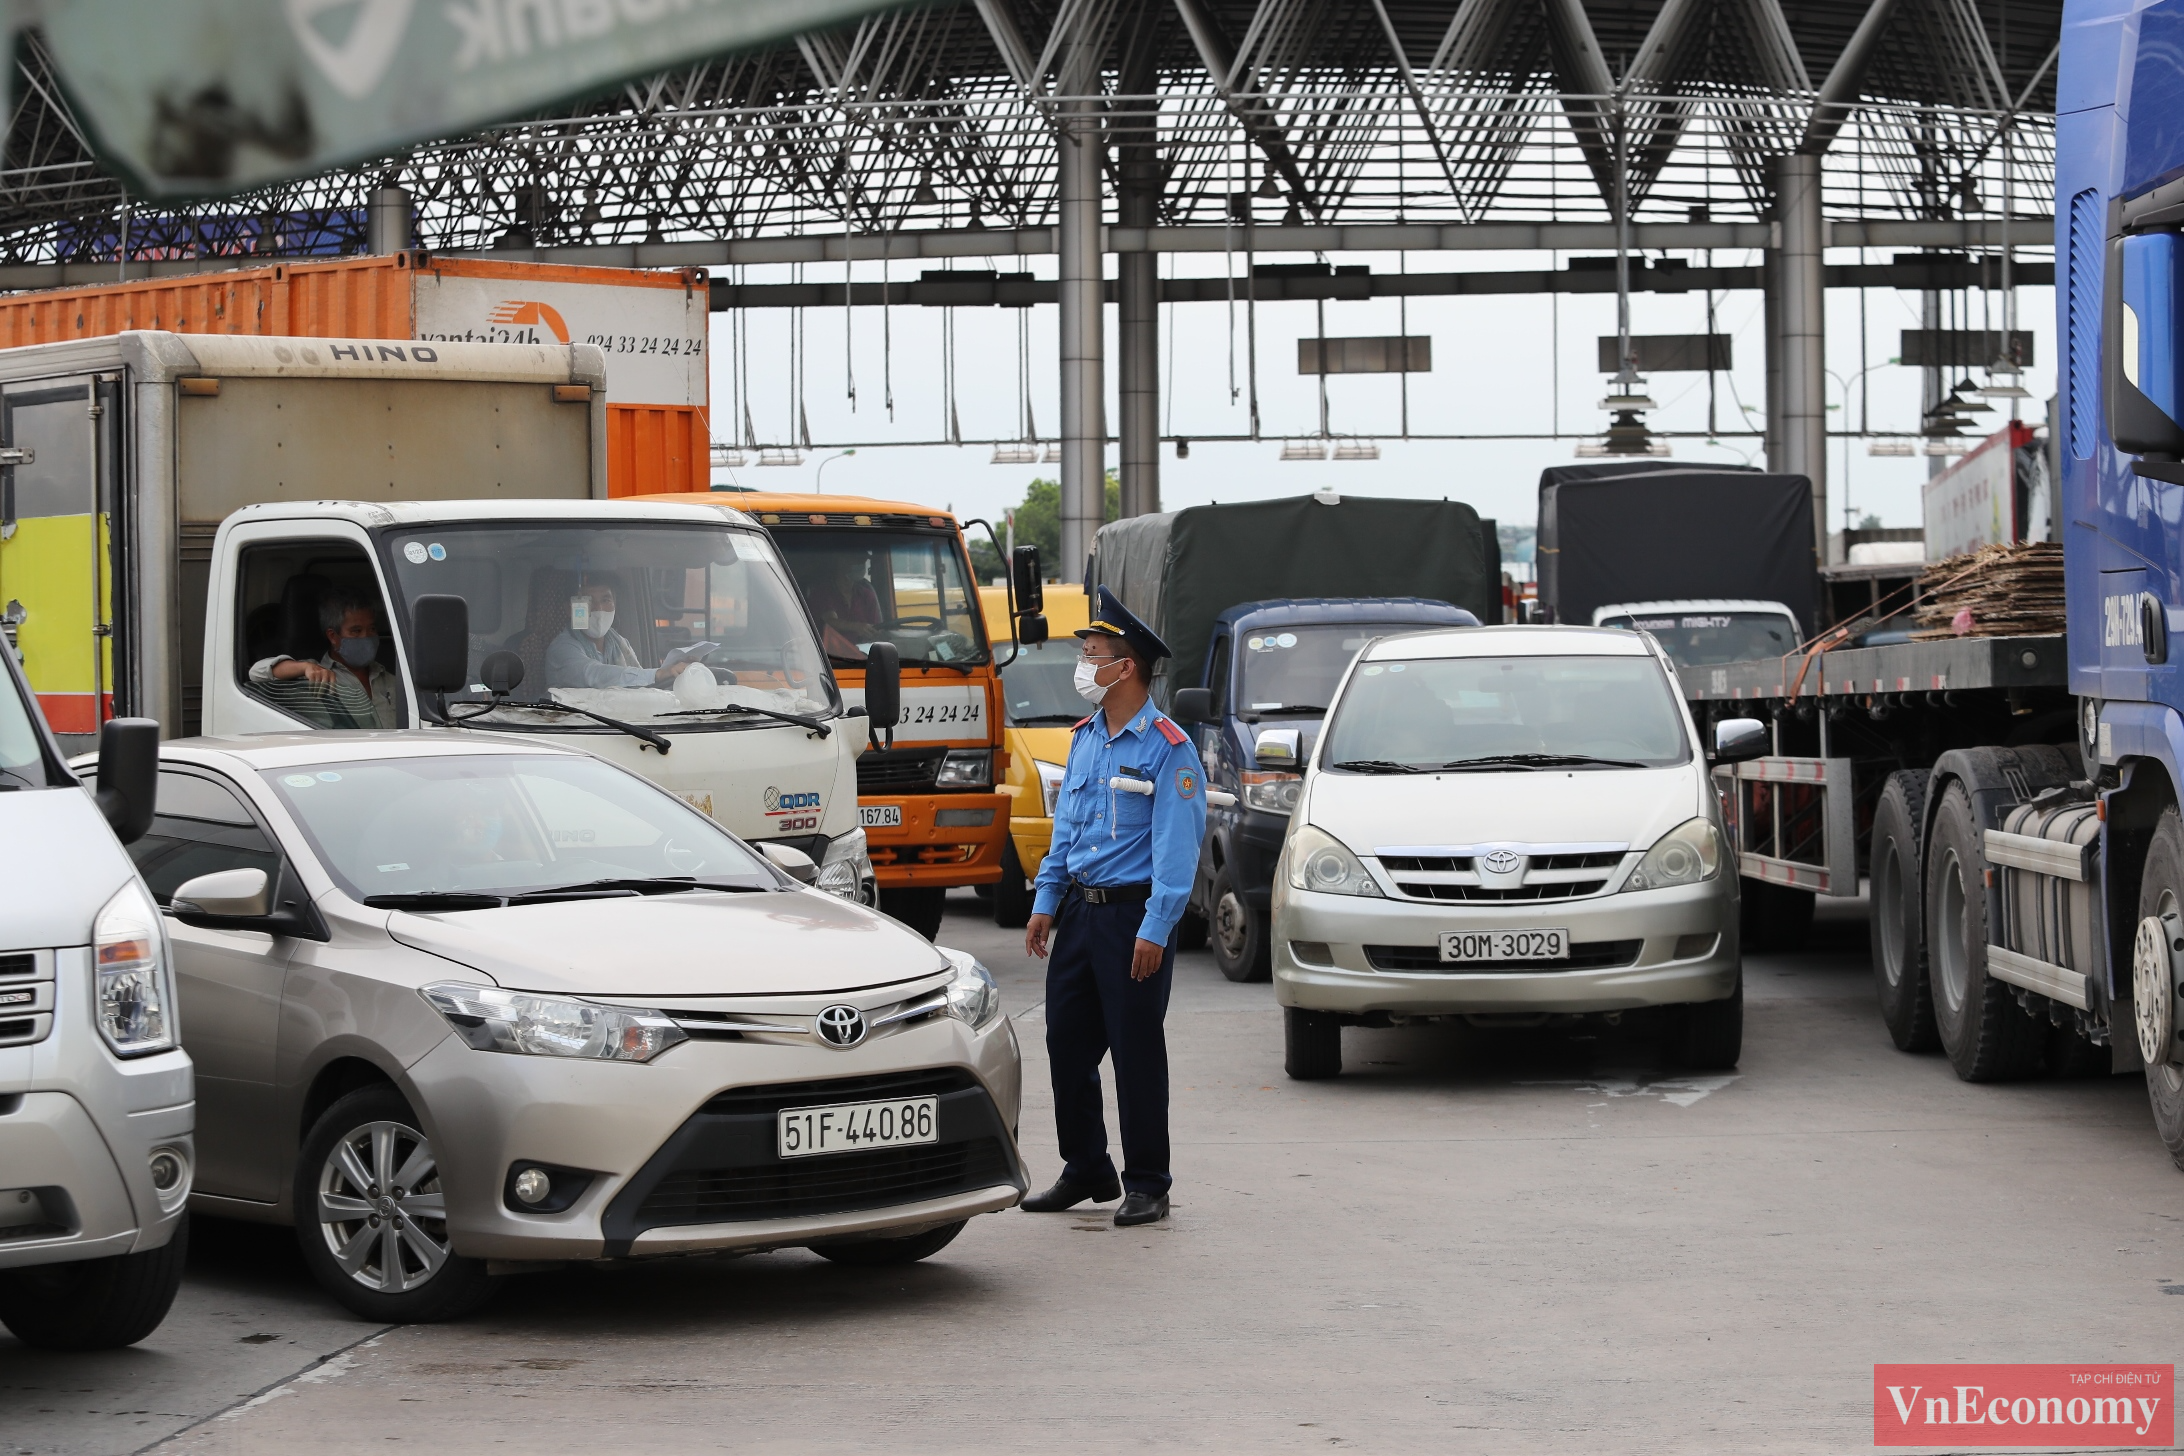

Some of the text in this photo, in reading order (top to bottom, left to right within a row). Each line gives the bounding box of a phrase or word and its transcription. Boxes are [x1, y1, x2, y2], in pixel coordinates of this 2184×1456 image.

[329, 345, 438, 362] HINO
[617, 336, 636, 353] 33
[640, 337, 658, 354] 24
[662, 338, 680, 356] 24
[683, 339, 702, 356] 24
[1681, 616, 1732, 628] MIGHTY
[915, 706, 935, 724] 24
[939, 705, 958, 722] 24
[962, 705, 979, 722] 24
[779, 792, 820, 809] QDR
[779, 816, 817, 831] 300
[859, 808, 900, 825] 167.84
[549, 829, 596, 842] INO
[1448, 932, 1561, 959] 30M-3029
[785, 1103, 932, 1151] 51F-440.86
